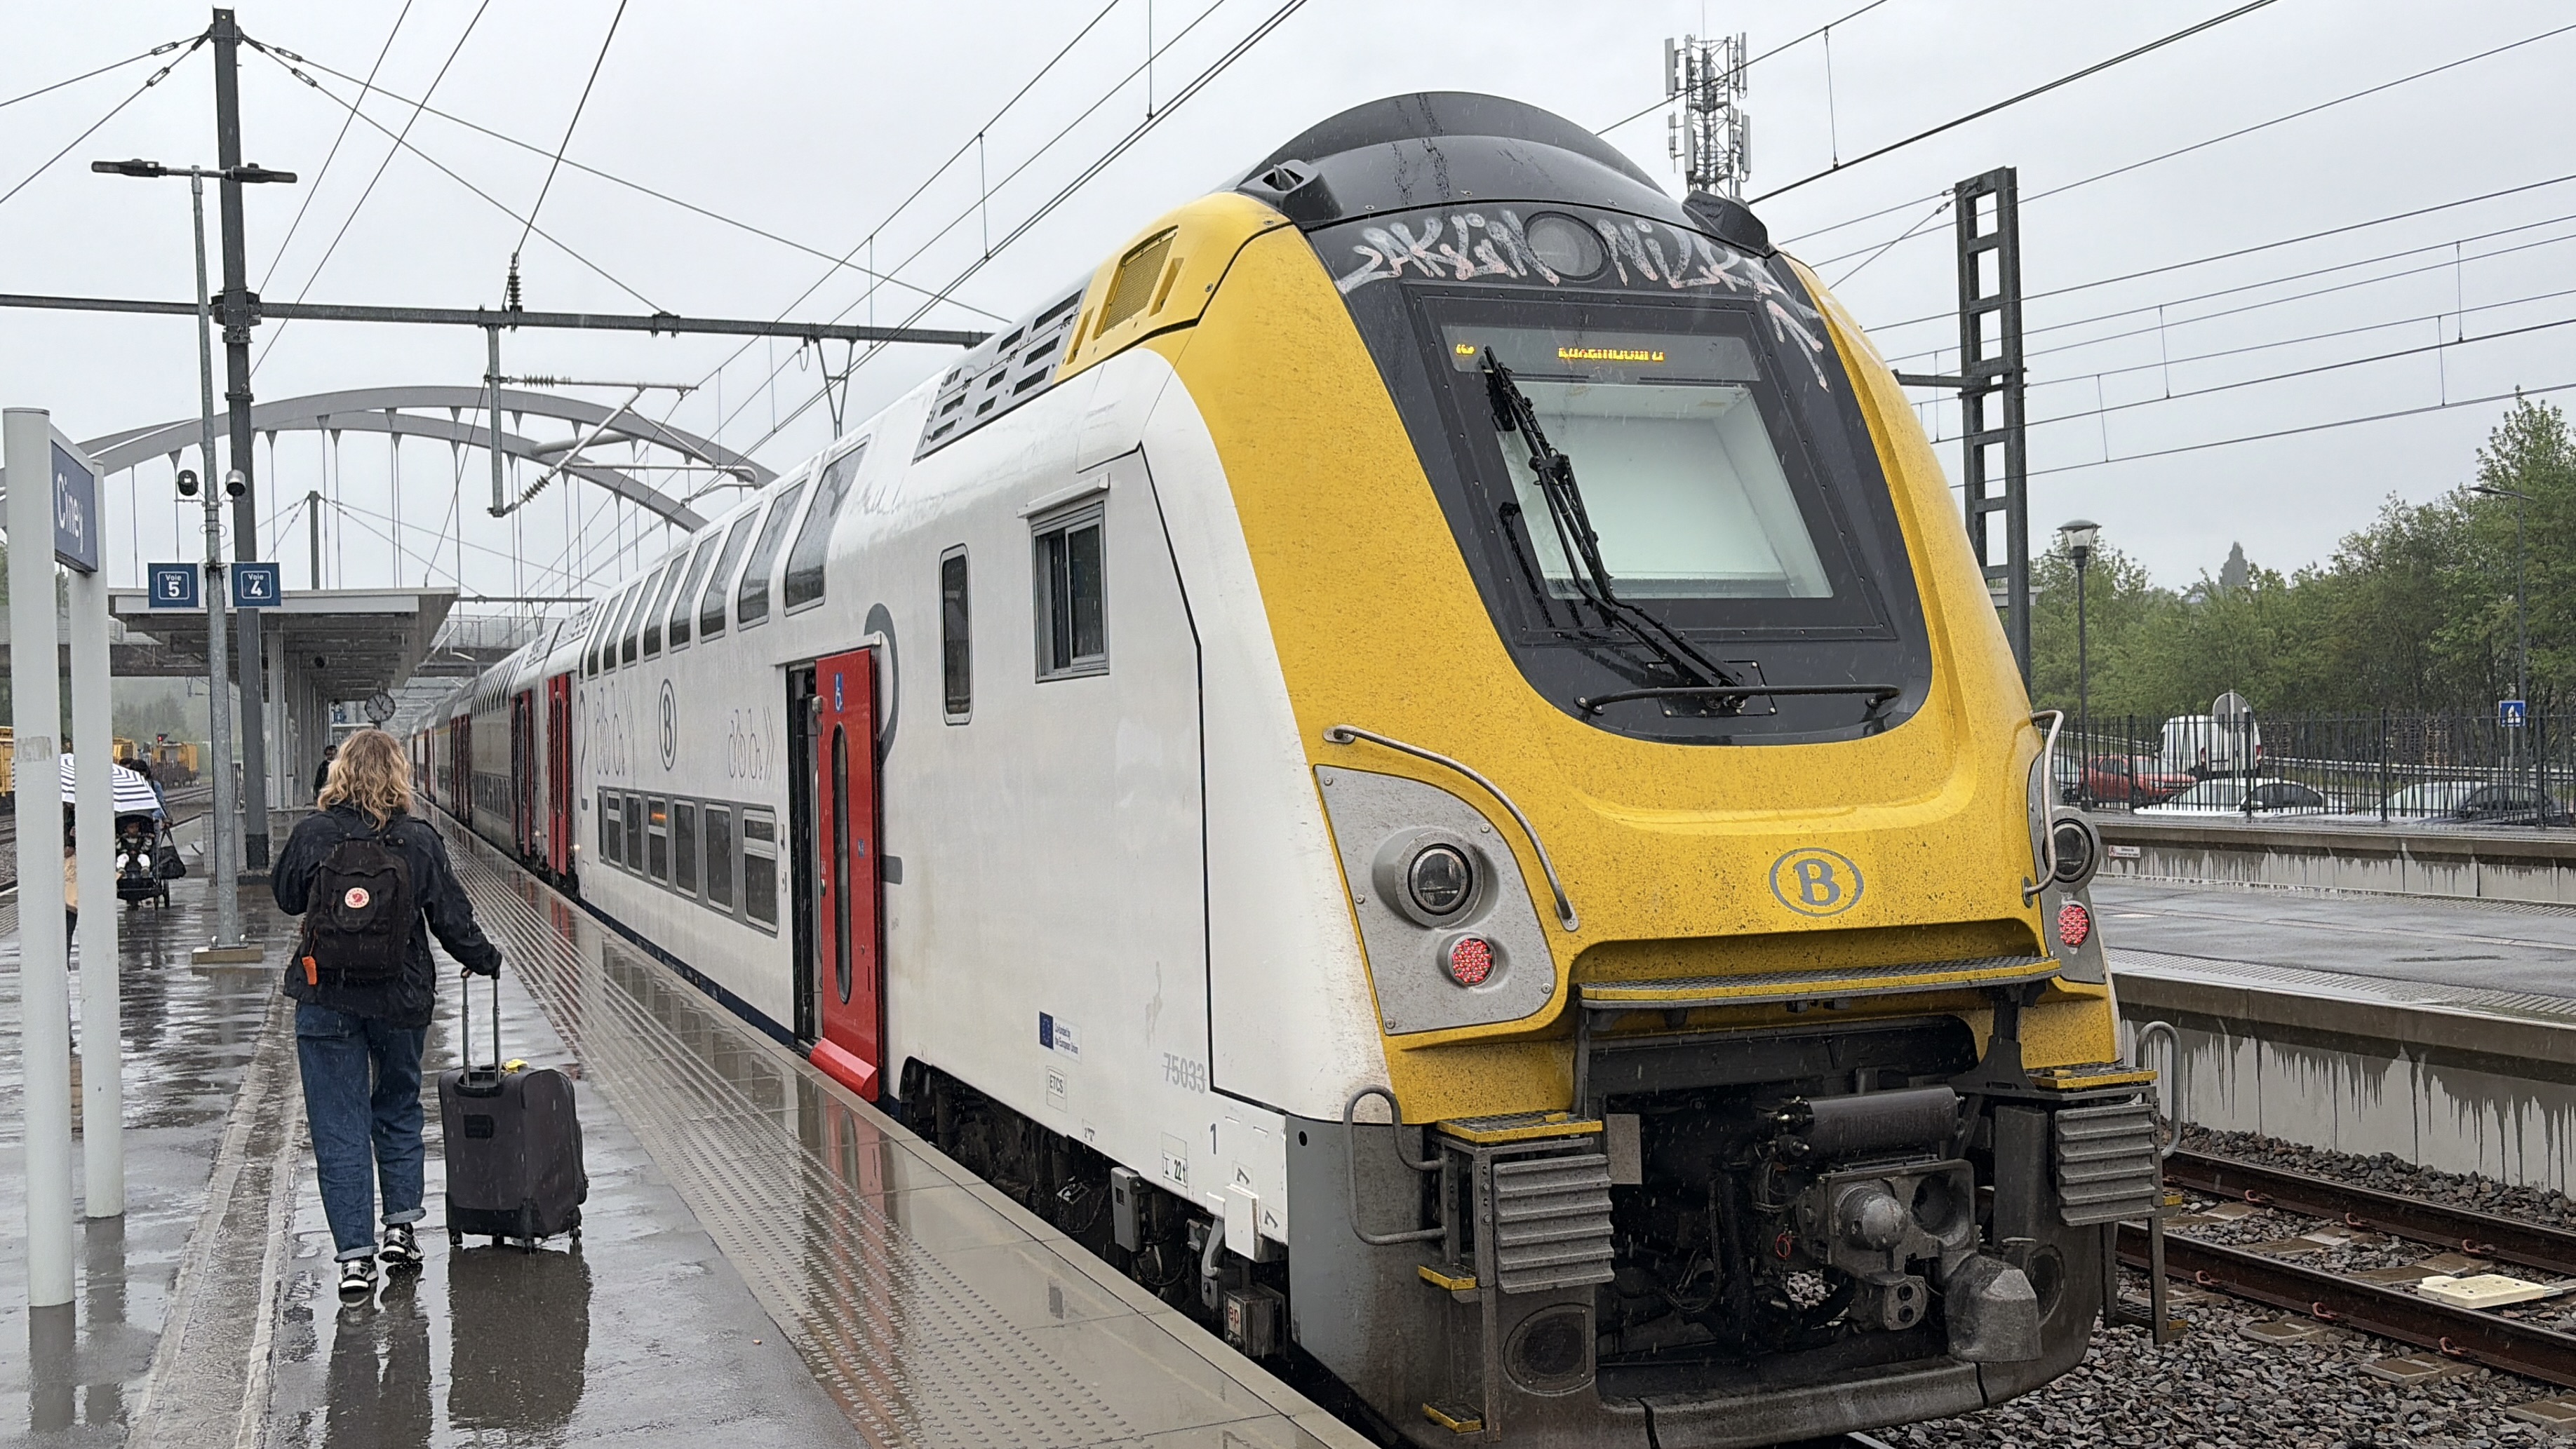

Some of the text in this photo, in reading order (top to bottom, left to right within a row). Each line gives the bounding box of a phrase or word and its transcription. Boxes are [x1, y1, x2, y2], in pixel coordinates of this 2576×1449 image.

[58, 473, 83, 553] Ciney
[168, 581, 180, 597] 5
[250, 581, 262, 596] 4
[1049, 1074, 1064, 1094] ETCS
[1162, 1052, 1207, 1094] 75033
[1210, 1123, 1216, 1155] 1
[1229, 1306, 1239, 1328] ep
